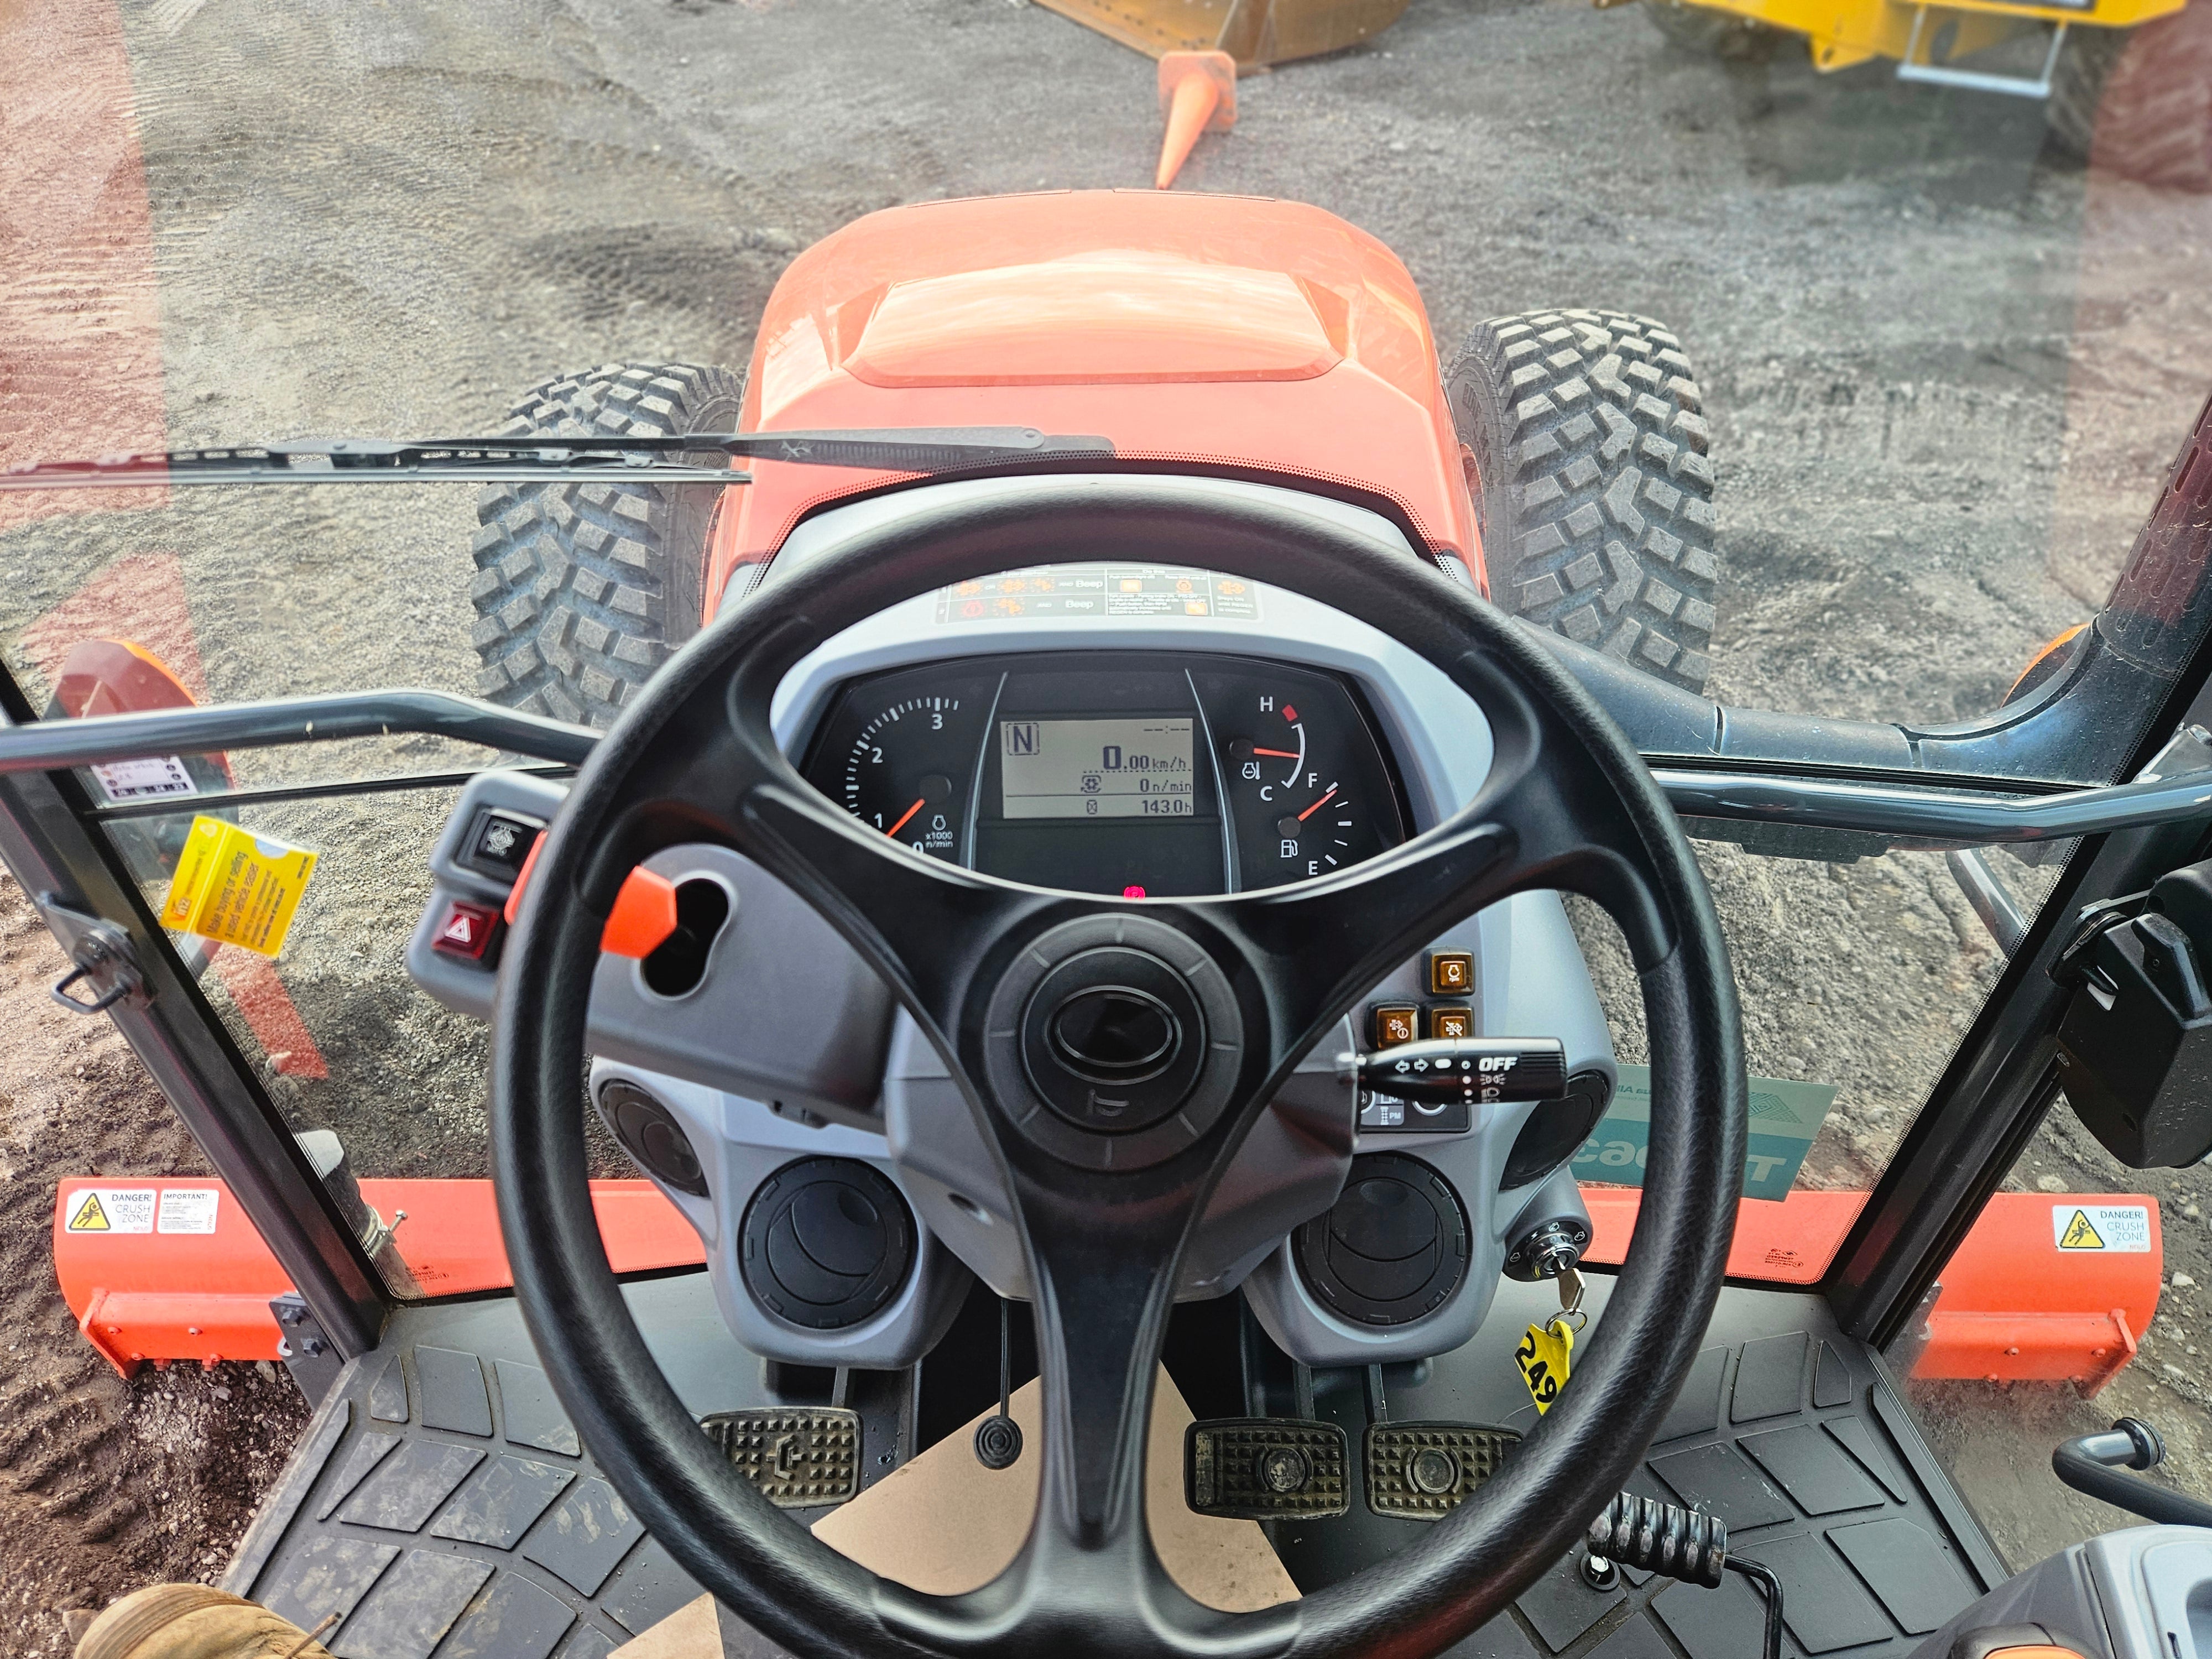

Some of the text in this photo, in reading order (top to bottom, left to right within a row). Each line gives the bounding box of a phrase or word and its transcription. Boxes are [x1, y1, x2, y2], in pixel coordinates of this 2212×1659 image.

[1076, 580, 1104, 588] Beep
[1065, 599, 1094, 609] Beep
[1260, 696, 1273, 712] H
[932, 714, 943, 729] 3
[1014, 726, 1032, 753] N
[872, 747, 883, 763] 2
[1152, 757, 1186, 769] km/h
[1140, 779, 1191, 792] 0 n/min
[1308, 773, 1318, 788] F
[1260, 785, 1273, 801] C
[874, 813, 883, 828] 1
[925, 831, 953, 840] x1000
[925, 840, 953, 848] n/min
[1308, 861, 1318, 875] E
[207, 850, 249, 933] Make buying or selling
[227, 912, 241, 933] used
[234, 887, 251, 913] vehicle
[243, 861, 259, 888] easier
[1479, 1057, 1518, 1071] OFF
[115, 1204, 150, 1213] CRUSH
[2100, 1211, 2143, 1219] DANGER!
[122, 1214, 149, 1223] ZONE
[2107, 1221, 2144, 1232] CRUSH
[2116, 1232, 2145, 1241] ZONE
[1514, 1331, 1557, 1403] 249
